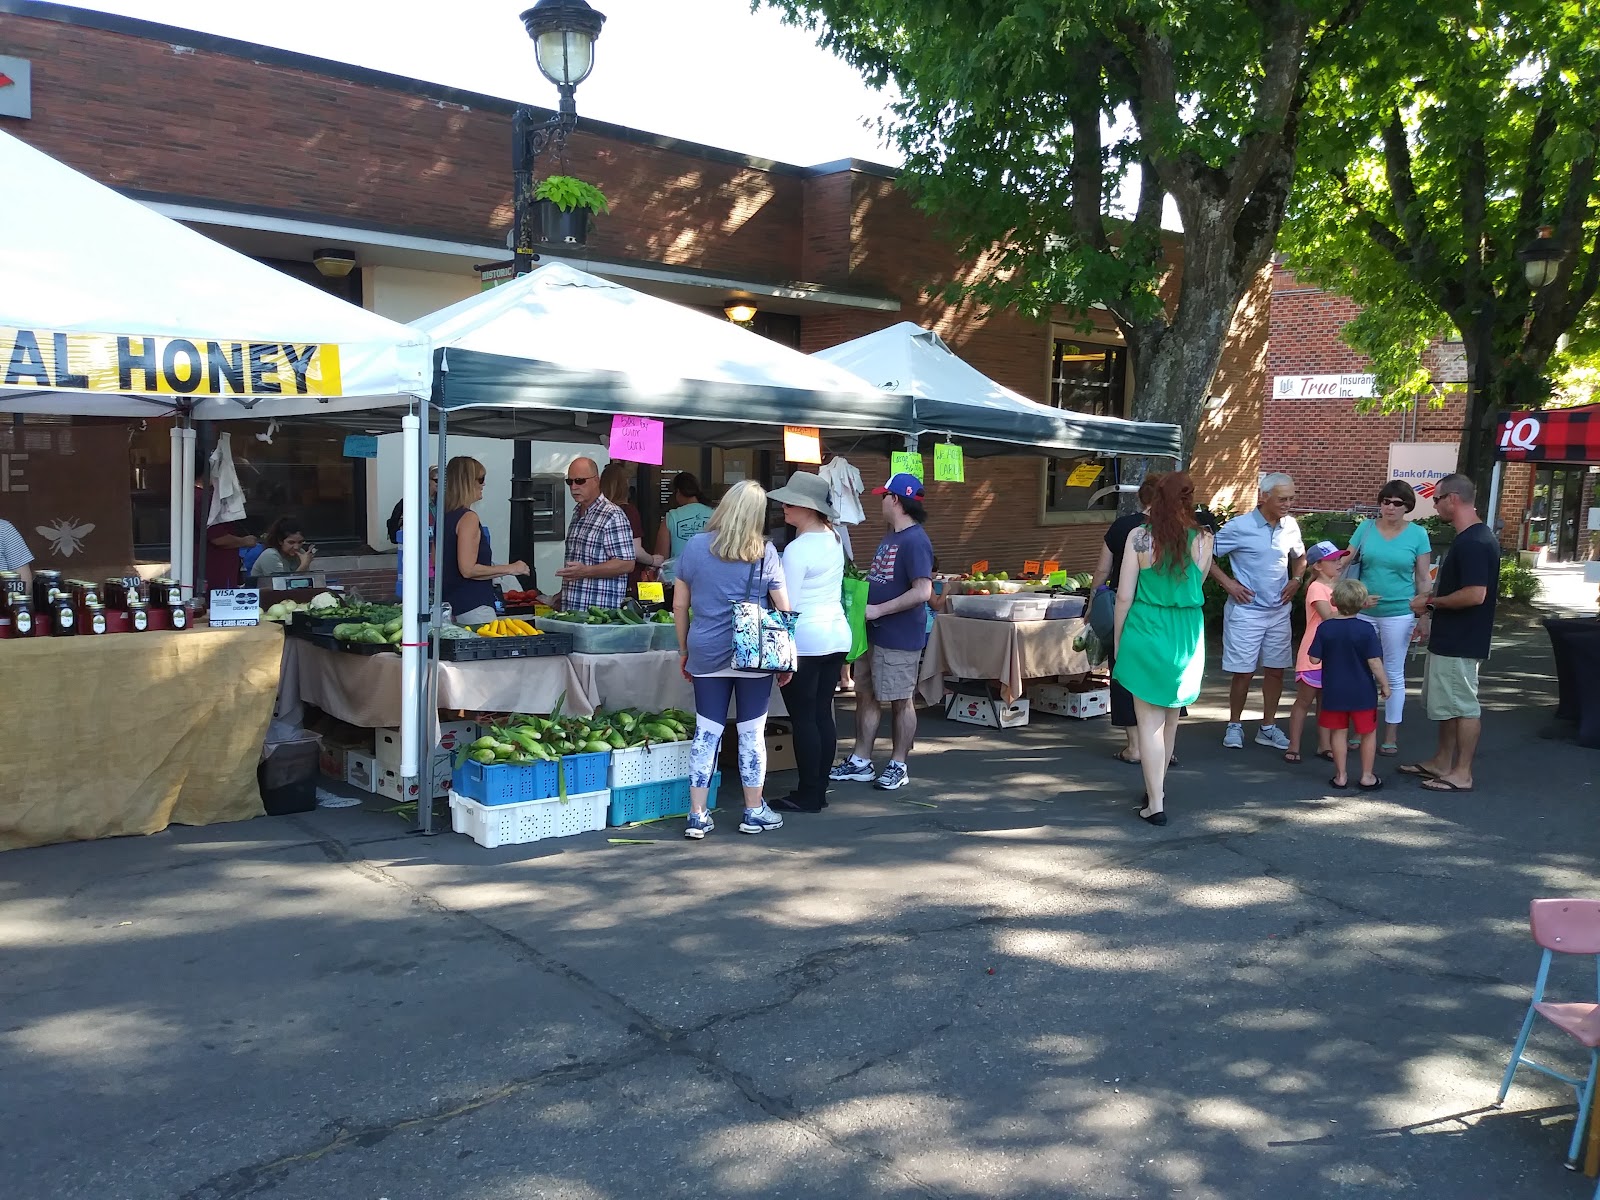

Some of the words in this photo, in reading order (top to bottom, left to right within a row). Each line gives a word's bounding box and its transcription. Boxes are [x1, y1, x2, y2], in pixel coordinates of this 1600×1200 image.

[482, 267, 512, 280] HISTORIC
[0, 330, 89, 389] AL
[117, 336, 318, 394] HONEY
[1340, 375, 1376, 385] Insuranc
[1300, 377, 1338, 396] True
[1339, 387, 1354, 397] Inc.
[1500, 418, 1540, 451] iQ
[1393, 469, 1415, 478] Bank
[1416, 470, 1427, 479] of
[7, 581, 24, 592] $18
[122, 576, 140, 588] $10
